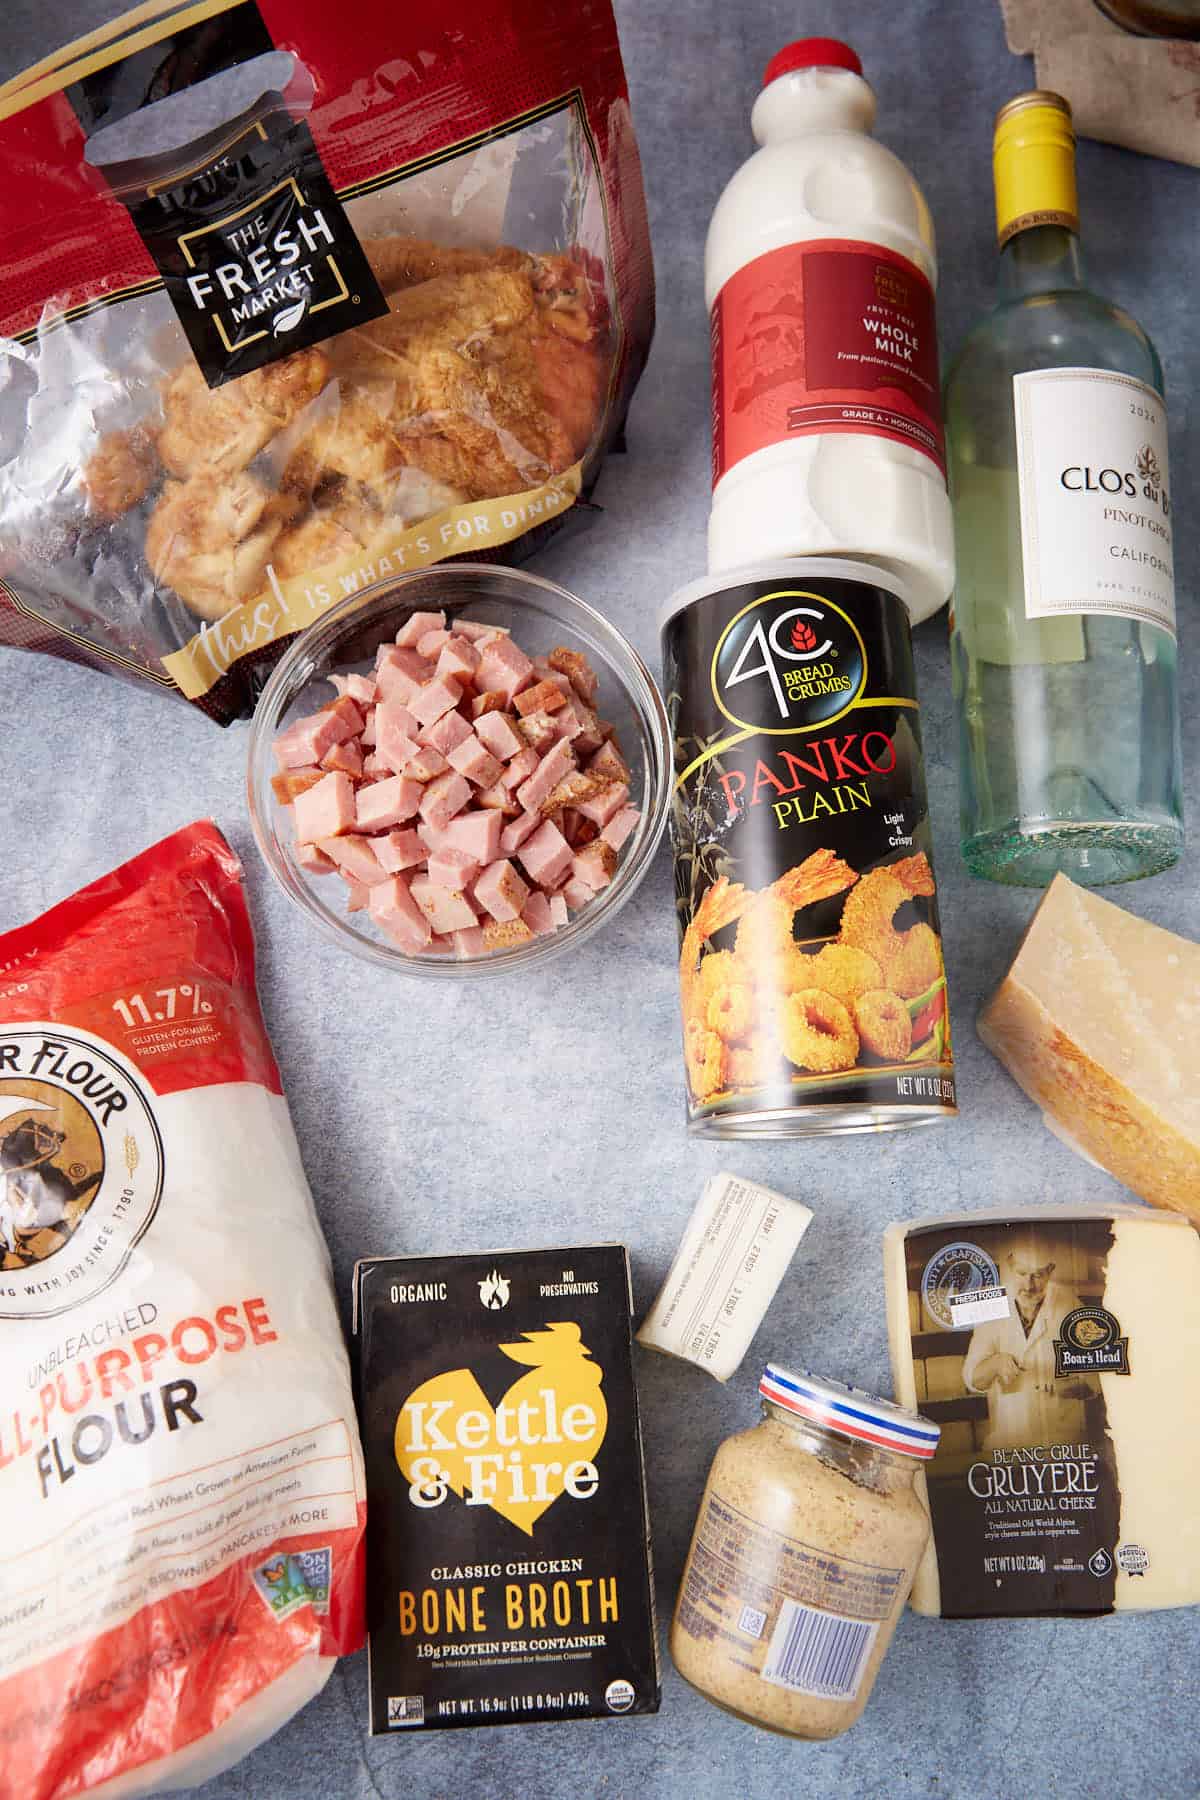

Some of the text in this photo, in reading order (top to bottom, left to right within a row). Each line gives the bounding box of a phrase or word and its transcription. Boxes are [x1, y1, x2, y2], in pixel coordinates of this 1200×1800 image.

[227, 215, 268, 250] THE
[187, 209, 335, 309] FRESH
[231, 264, 315, 323] MARKET
[863, 318, 919, 351] WHOLE
[875, 336, 913, 362] MILK
[841, 409, 875, 420] GRADE
[1130, 403, 1156, 424] 2024
[1061, 466, 1137, 498] CLOS
[1143, 481, 1159, 504] du
[1103, 507, 1147, 529] PINOT
[304, 582, 332, 609] IS
[338, 536, 432, 594] WHAT'S
[440, 515, 492, 548] FOR
[782, 663, 834, 687] BREAD
[788, 676, 852, 702] CRUMBS
[718, 731, 897, 817] PANKO
[772, 782, 873, 829] PLAIN
[884, 812, 905, 825] Light
[888, 836, 913, 848] Crispy
[112, 984, 214, 1027] 11.7%
[131, 1024, 215, 1046] GLUTEN-FORMING
[136, 1042, 178, 1057] PROTEIN
[29, 1039, 128, 1128] FLOUR
[896, 1076, 913, 1096] NET
[914, 1076, 927, 1096] WT
[24, 1278, 61, 1296] WITH
[66, 1264, 88, 1284] JOY
[85, 1225, 114, 1266] SINCE
[112, 1188, 135, 1220] 1790
[562, 1270, 575, 1282] NO
[390, 1283, 448, 1304] ORGANIC
[540, 1281, 600, 1297] PRESERVATIVES
[955, 1290, 1002, 1305] FRESH FOODS
[26, 1302, 159, 1390] UNBLEACHED
[1062, 1348, 1121, 1366] Boar's Head
[402, 1388, 598, 1453] Kettle
[35, 1378, 205, 1498] FLOUR
[993, 1446, 1044, 1464] BLANC
[157, 1487, 194, 1510] Wheat
[195, 1479, 231, 1496] Grown
[244, 1454, 289, 1474] American
[408, 1449, 600, 1509] & Fire
[968, 1462, 1099, 1498] GRUYERE
[289, 1508, 329, 1526] MORE
[984, 1496, 1097, 1515] ALL NATURAL CHEESE
[1022, 1519, 1034, 1527] Old
[431, 1558, 584, 1581] CLASSIC CHICKEN
[984, 1557, 998, 1573] NET
[999, 1556, 1010, 1571] WT
[1016, 1555, 1025, 1570] OZ
[399, 1586, 488, 1637] BONE
[505, 1576, 621, 1631] BROTH
[416, 1634, 608, 1659] 19g PROTEIN PER CONTAINER
[438, 1700, 457, 1714] NET
[461, 1699, 478, 1713] WT.
[522, 1696, 533, 1710] LB
